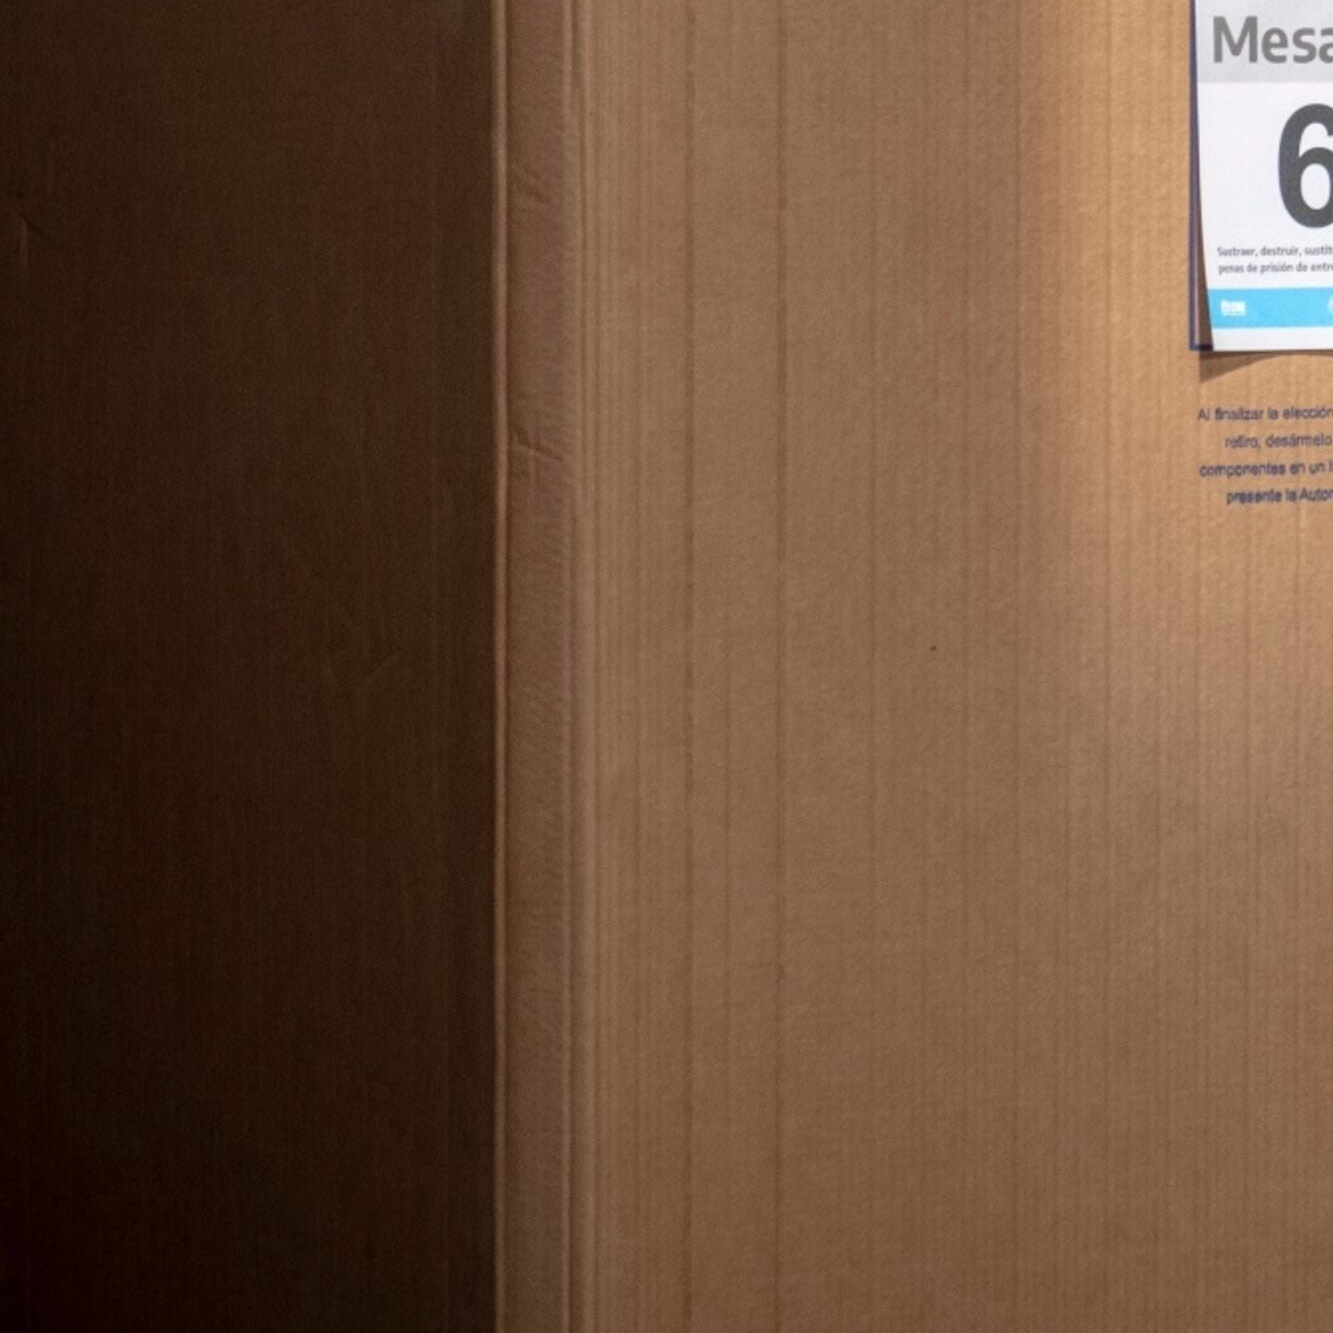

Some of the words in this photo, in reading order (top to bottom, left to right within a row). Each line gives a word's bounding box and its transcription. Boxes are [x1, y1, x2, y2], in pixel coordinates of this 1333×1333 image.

[1217, 246, 1258, 258] Sustraer,
[1261, 246, 1302, 258] destruir,
[1218, 263, 1244, 275] penas
[1247, 263, 1258, 274] de
[1260, 262, 1293, 275] prisión
[1295, 262, 1308, 273] de
[1198, 408, 1210, 421] Al
[1215, 406, 1264, 420] finalizar
[1267, 407, 1279, 420] la
[1225, 433, 1261, 451] retiro,
[1265, 432, 1332, 448] desármelo
[1200, 462, 1286, 479] componentes
[1289, 464, 1305, 475] en
[1309, 463, 1325, 474] un
[1226, 489, 1282, 505] presente
[1285, 488, 1297, 501] la
